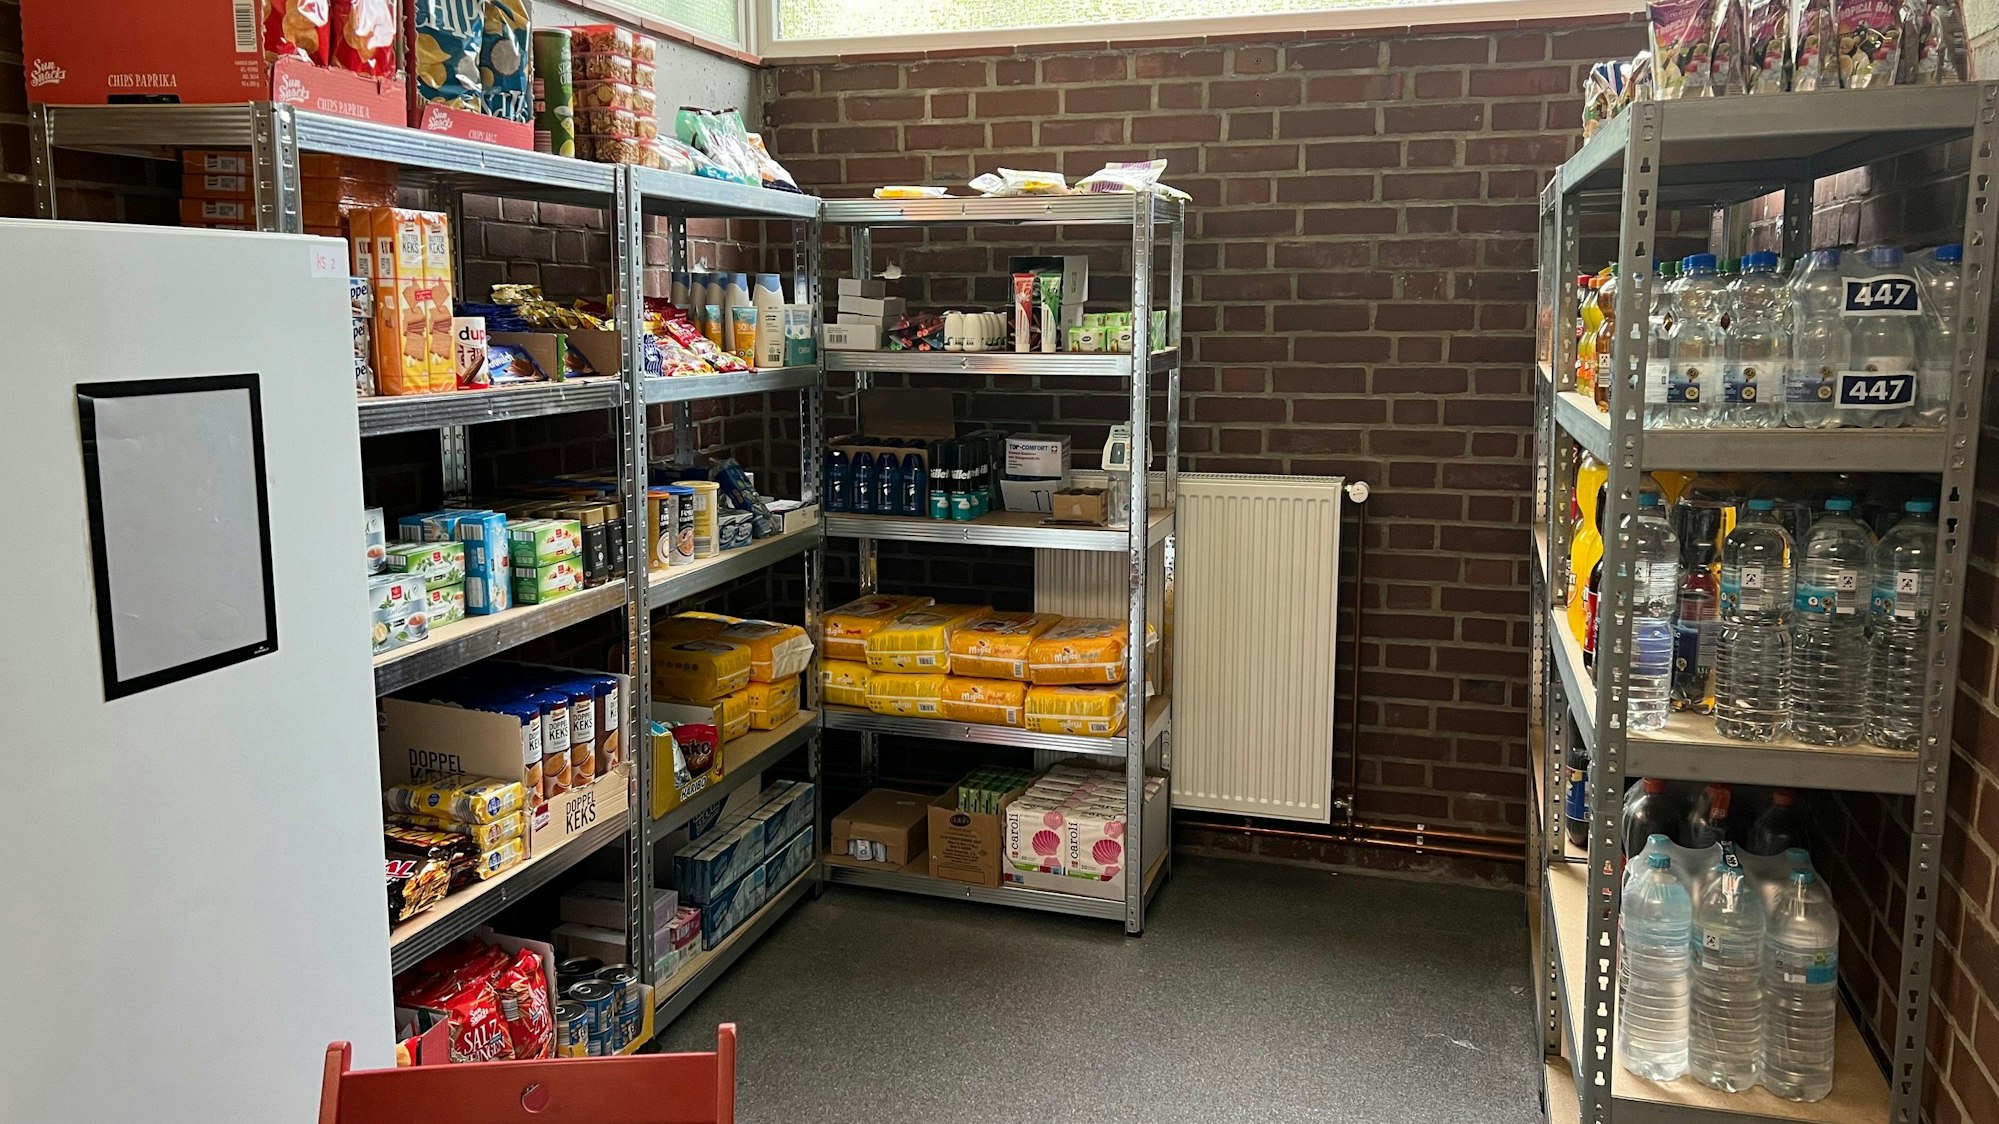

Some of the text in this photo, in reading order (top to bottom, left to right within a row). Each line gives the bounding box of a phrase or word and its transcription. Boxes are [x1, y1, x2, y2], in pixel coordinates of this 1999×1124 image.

[1875, 2, 1894, 14] BAY
[416, 0, 483, 38] HIP
[33, 58, 56, 73] Sun
[31, 67, 66, 87] Snacks
[108, 73, 177, 87] CHIPS PAPRIKA
[282, 73, 301, 89] Sun
[279, 84, 310, 103] Snacks
[317, 97, 370, 119] CHIPS PAPRIKA
[432, 107, 448, 120] Sun
[427, 114, 454, 131] Snacks
[468, 129, 484, 141] CHIPS
[402, 233, 418, 242] BUTTER
[428, 235, 445, 244] BUTTER
[402, 242, 420, 254] KEKS
[429, 242, 445, 255] KEKS
[330, 258, 336, 270] 2
[1854, 283, 1911, 307] 447
[459, 326, 486, 343] dup
[1849, 379, 1905, 400] 447
[930, 468, 949, 479] illet
[951, 469, 971, 480] illet
[549, 726, 569, 741] KEKS
[573, 719, 593, 732] KEKS
[409, 747, 465, 774] DOPPEL
[680, 776, 707, 802] HARIBO
[566, 790, 596, 815] DOPPEL
[566, 803, 596, 835] KEKS
[1009, 813, 1019, 850] caroli
[1068, 822, 1079, 859] caroli
[464, 1018, 501, 1056] SALZ
